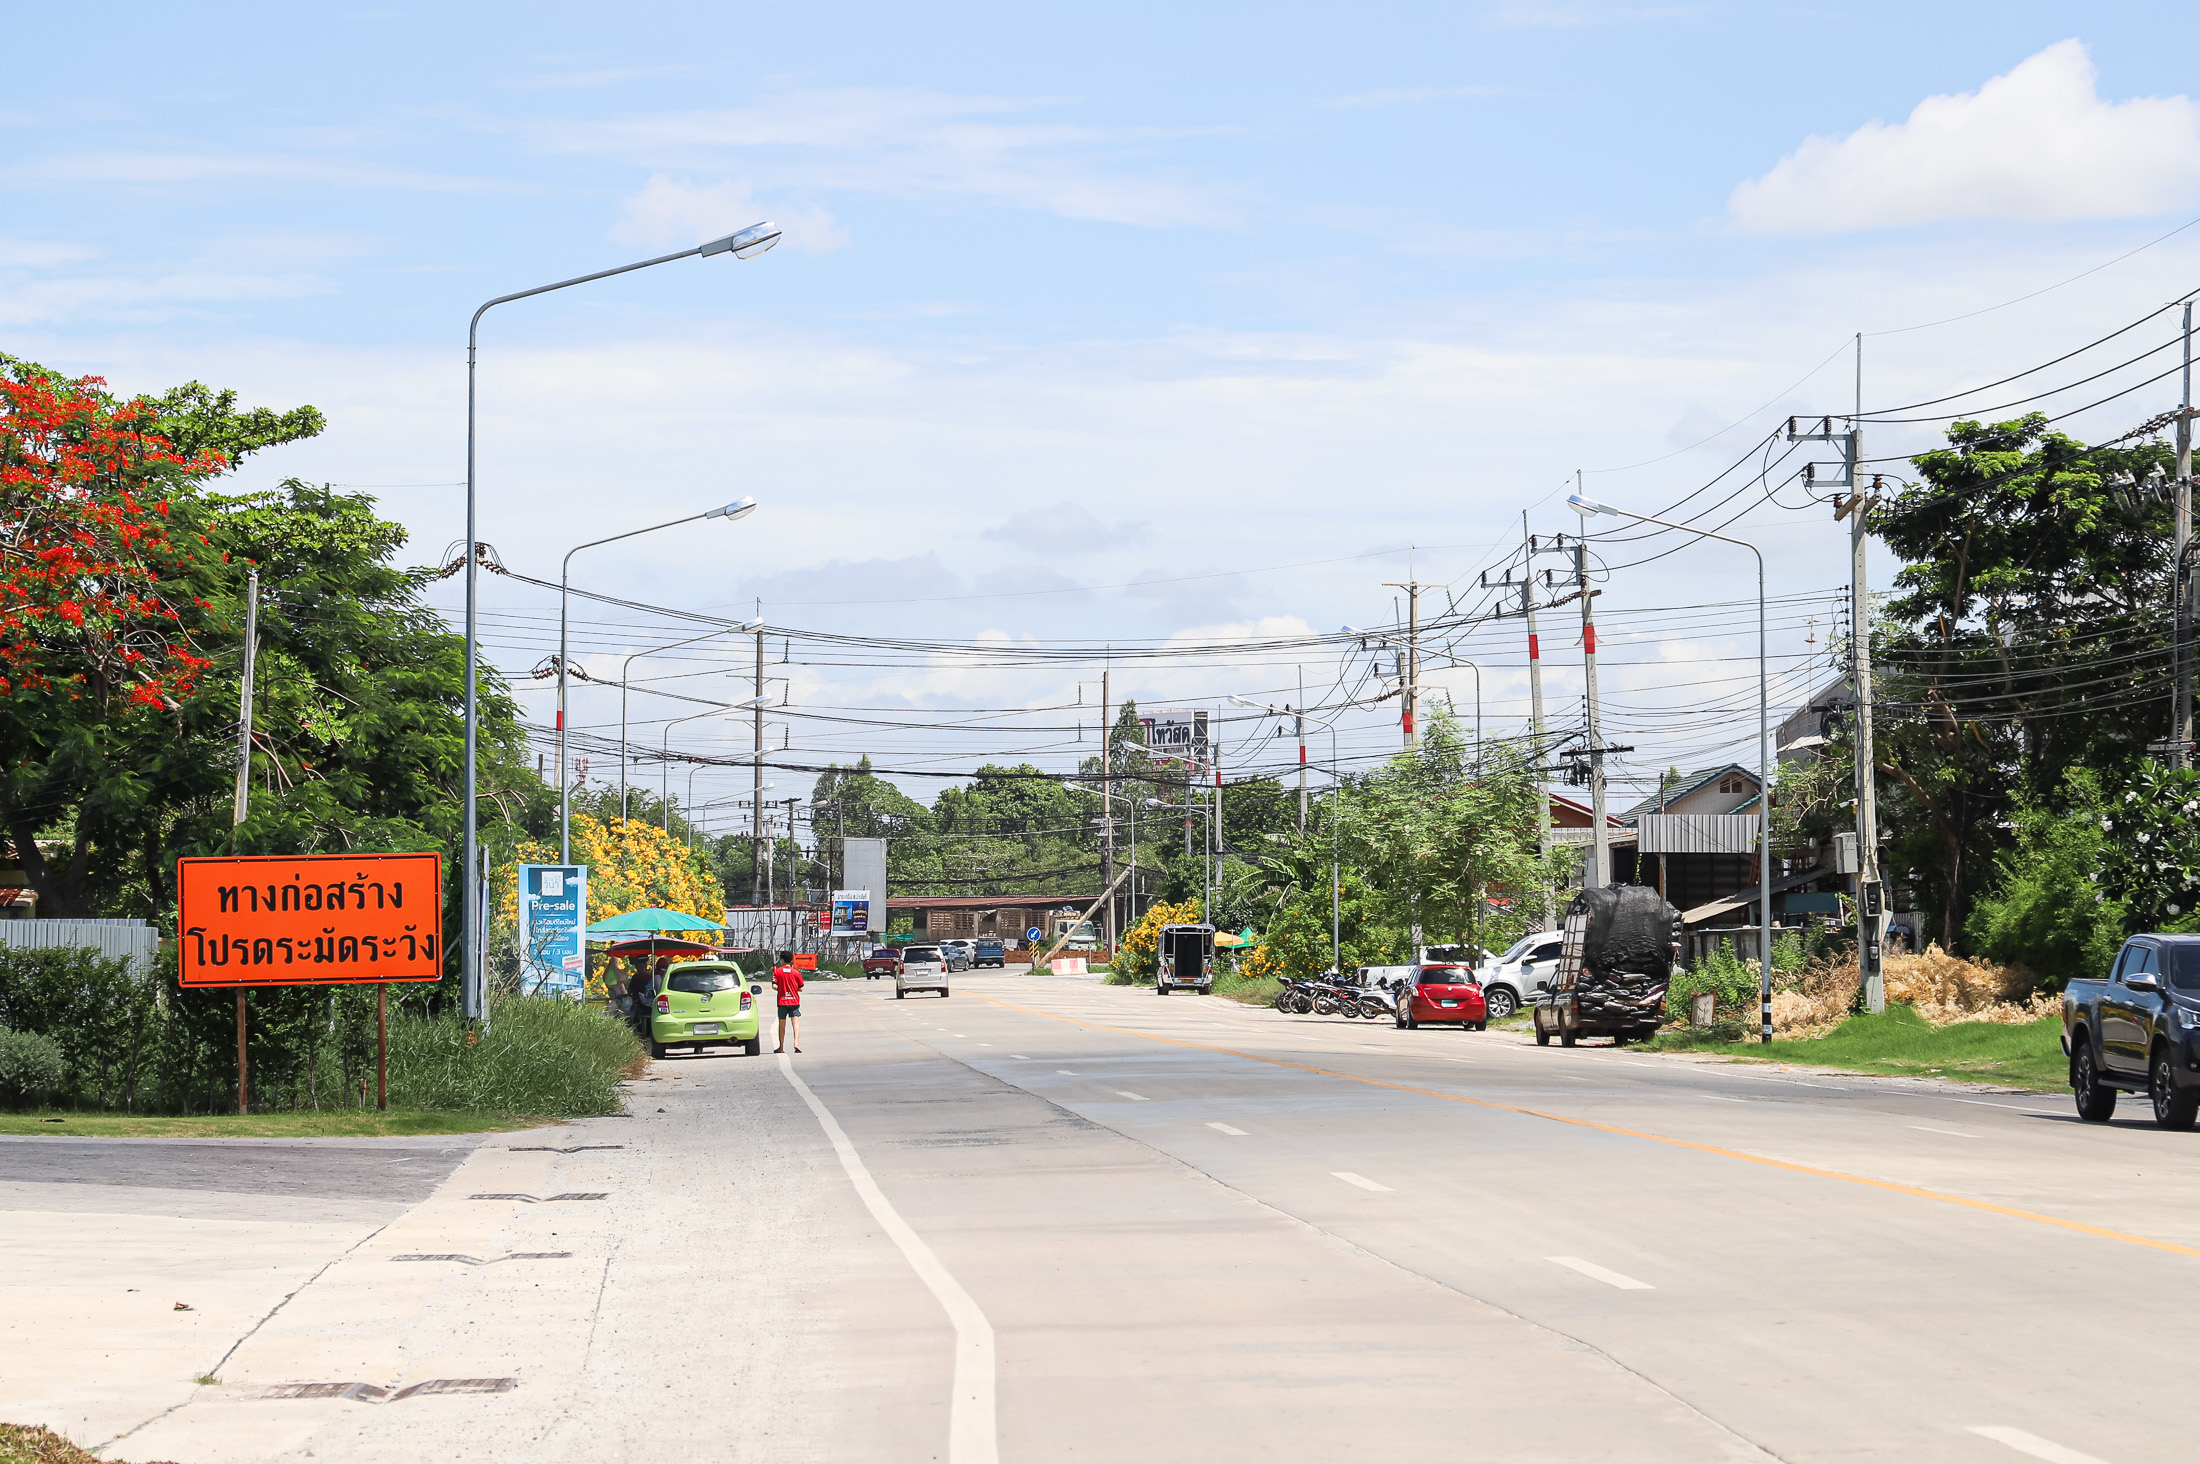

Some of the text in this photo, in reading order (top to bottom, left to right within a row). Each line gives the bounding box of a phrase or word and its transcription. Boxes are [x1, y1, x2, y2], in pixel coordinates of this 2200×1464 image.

[217, 872, 403, 913] ทางก่อสร้าง
[531, 900, 576, 911] Pre-sale
[186, 924, 435, 967] โปรดระมัดระวัง
[557, 948, 561, 956] 3
